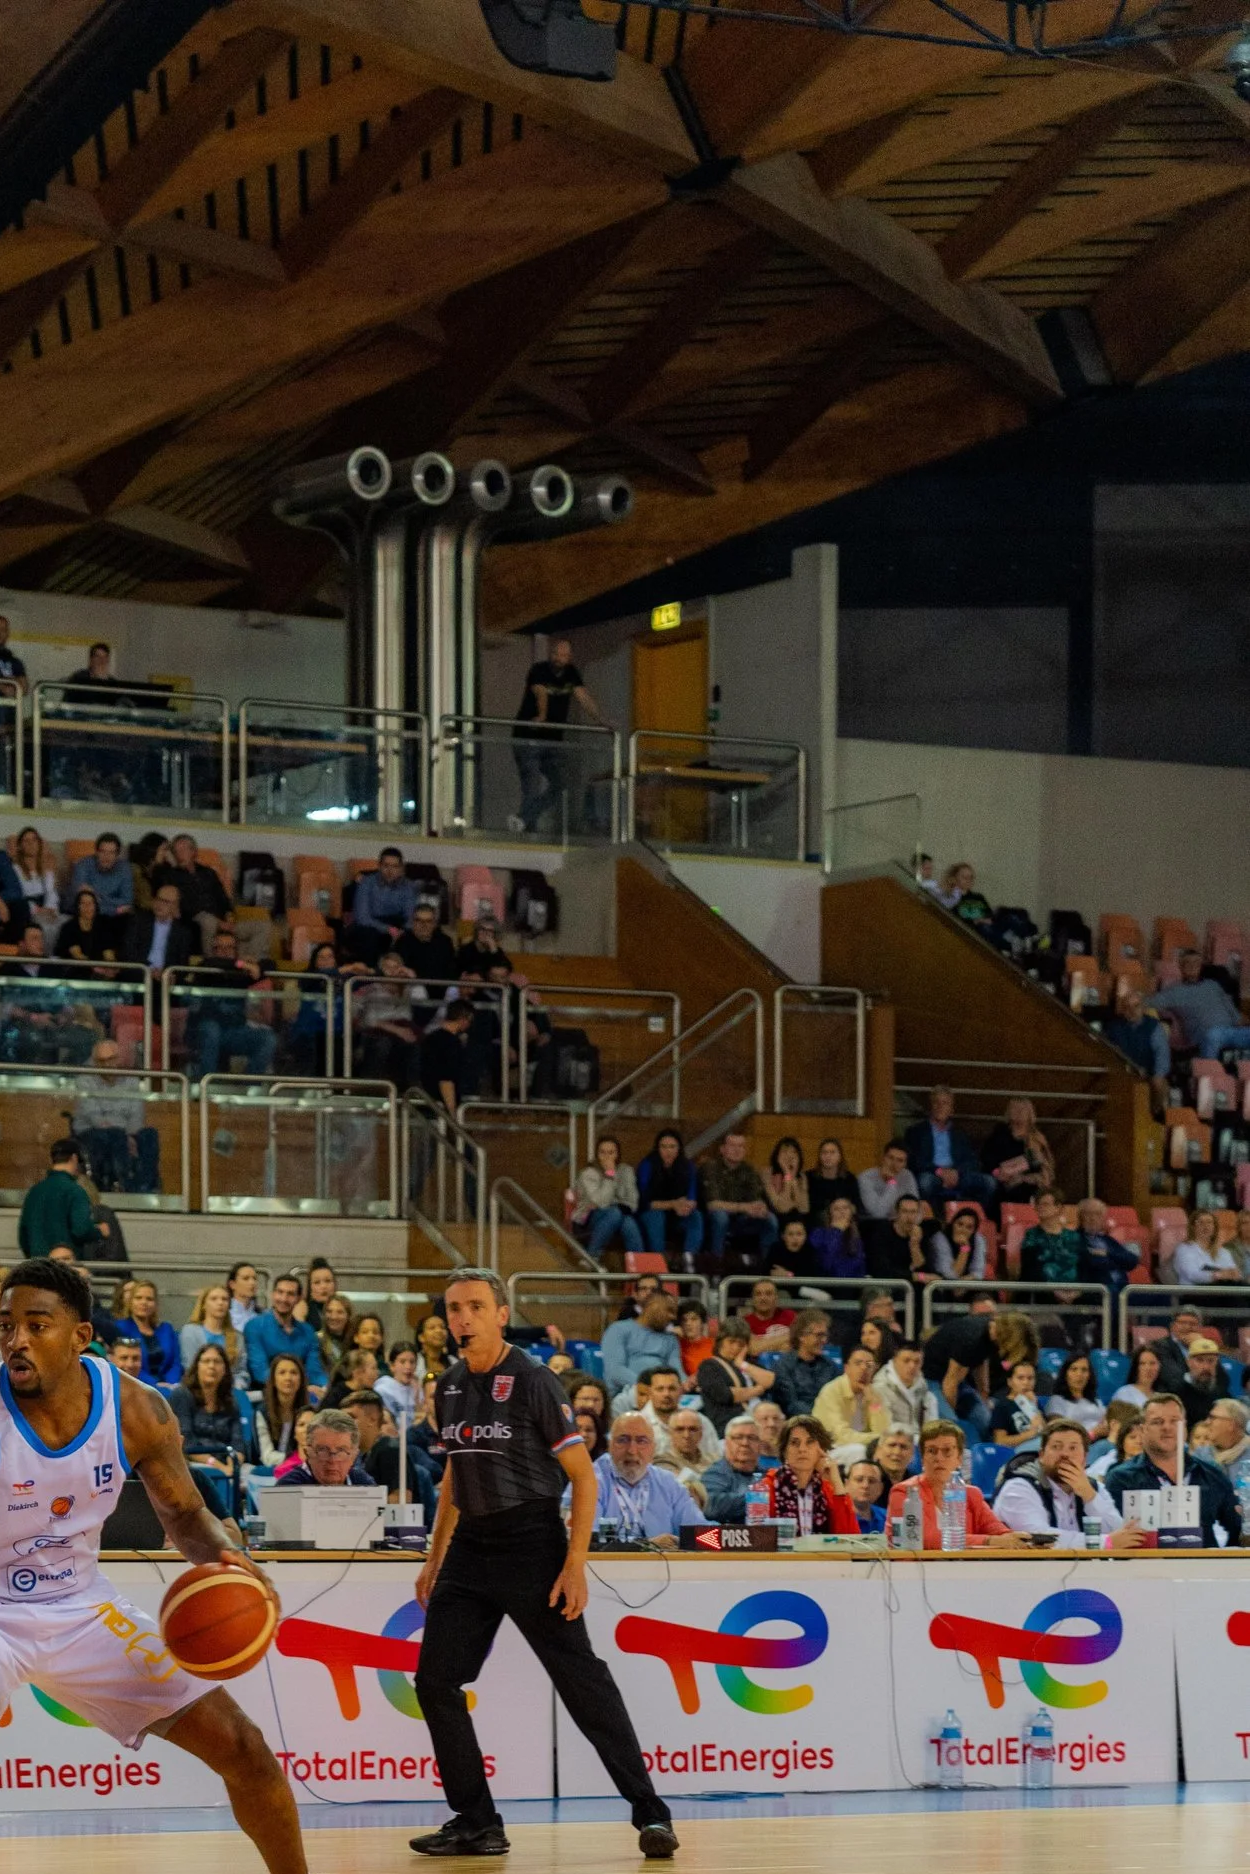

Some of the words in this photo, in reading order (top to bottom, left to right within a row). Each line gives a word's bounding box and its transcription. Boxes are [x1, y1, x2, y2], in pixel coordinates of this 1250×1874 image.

[93, 1463, 112, 1487] 15
[7, 1501, 39, 1512] Diekirch
[721, 1529, 752, 1548] POSS.
[641, 1740, 834, 1779] otalEnergies
